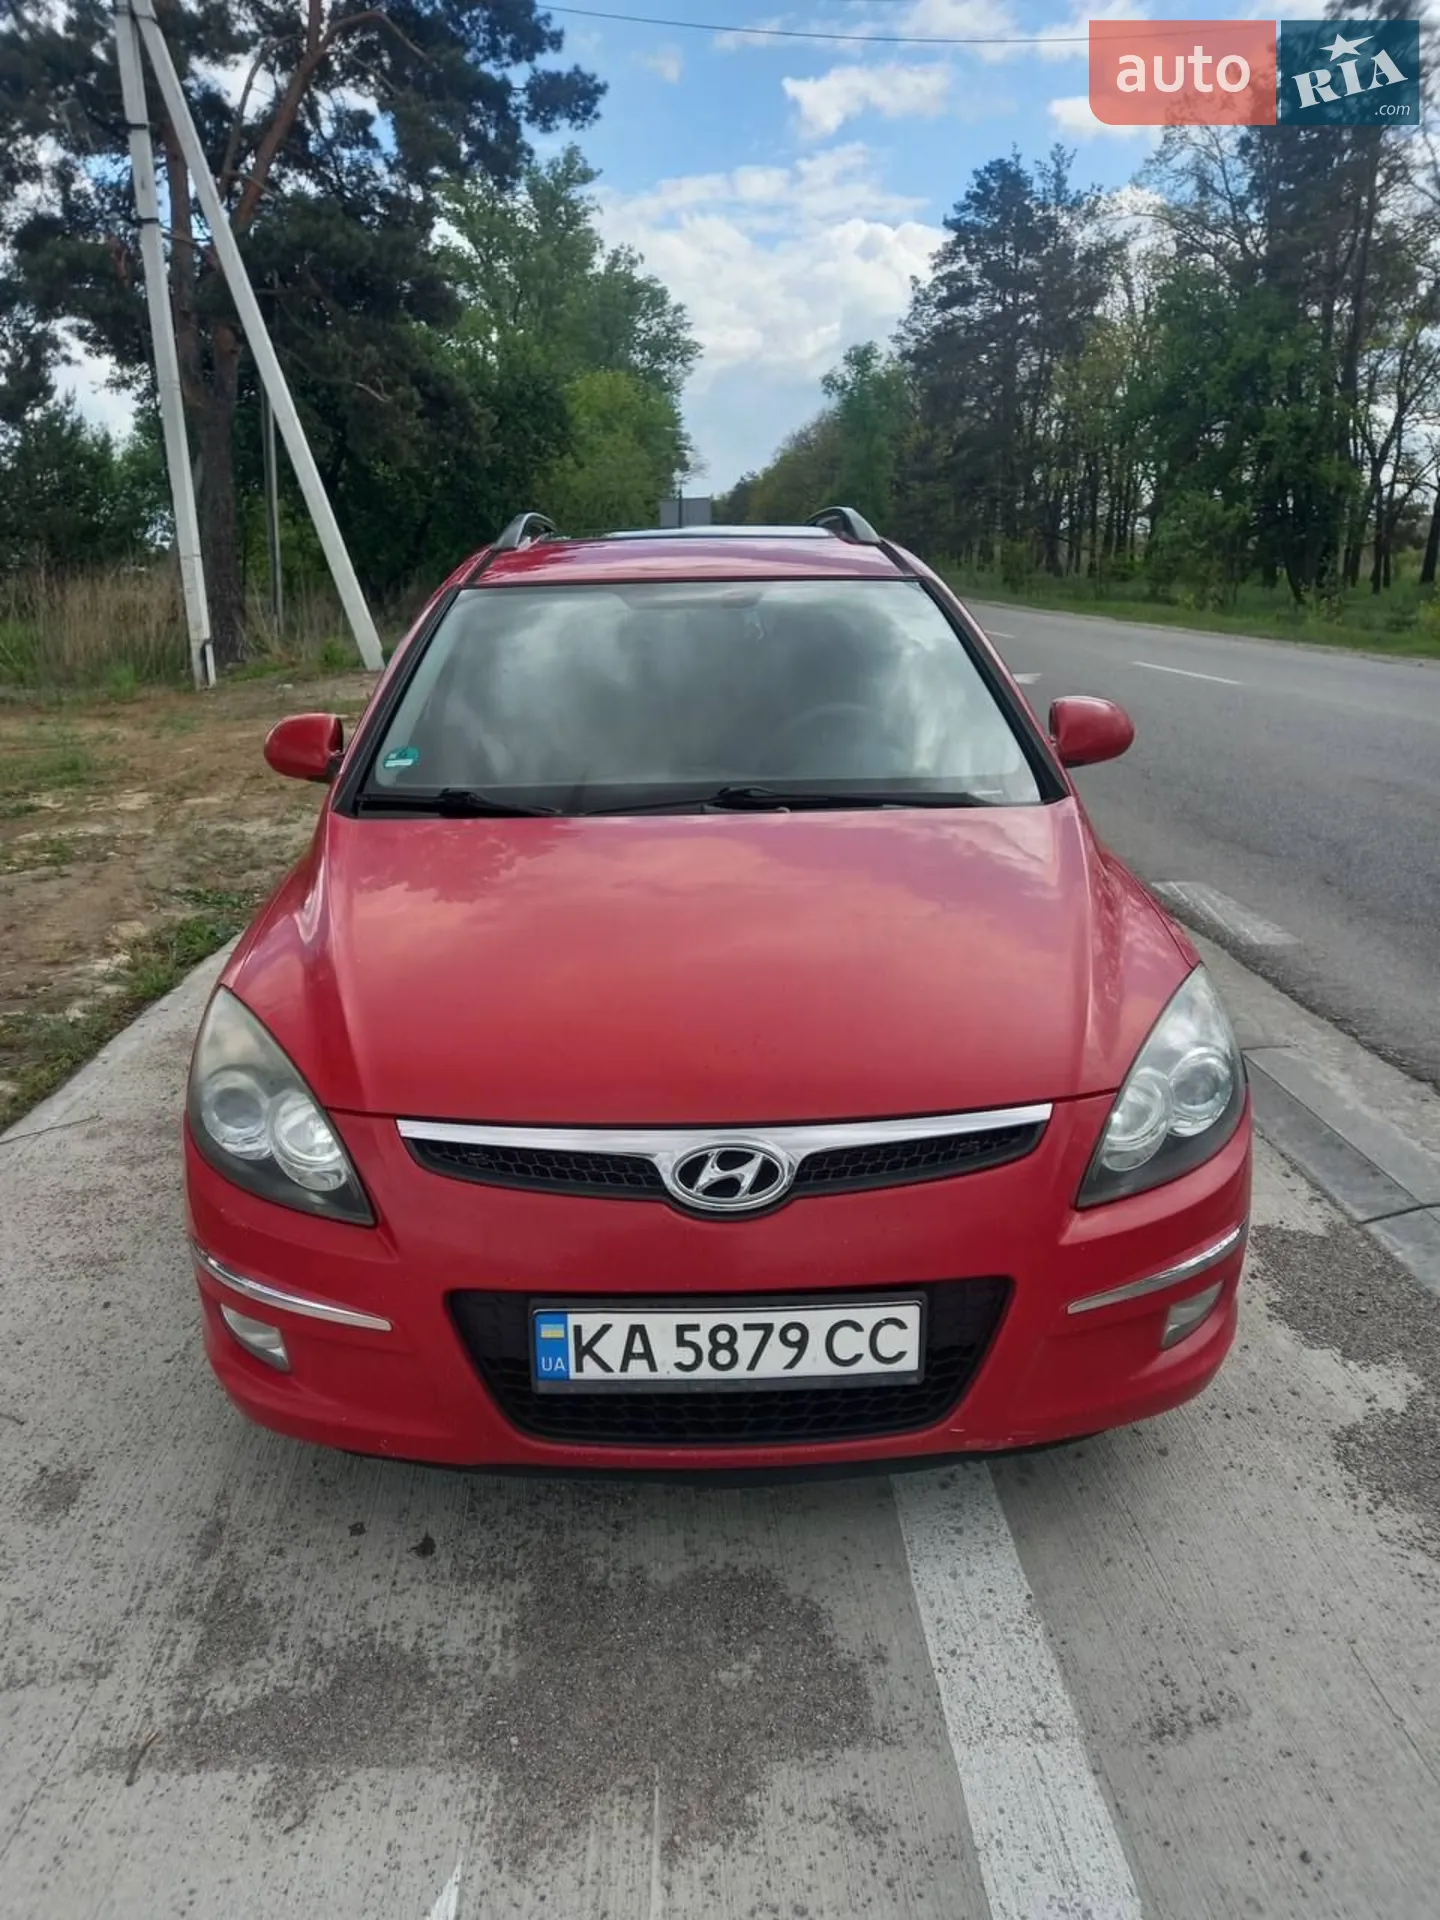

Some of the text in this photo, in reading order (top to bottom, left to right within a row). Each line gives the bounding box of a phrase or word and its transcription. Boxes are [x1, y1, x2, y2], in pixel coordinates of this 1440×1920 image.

[572, 1317, 909, 1373] KA 5879 CC
[541, 1357, 566, 1372] UA
